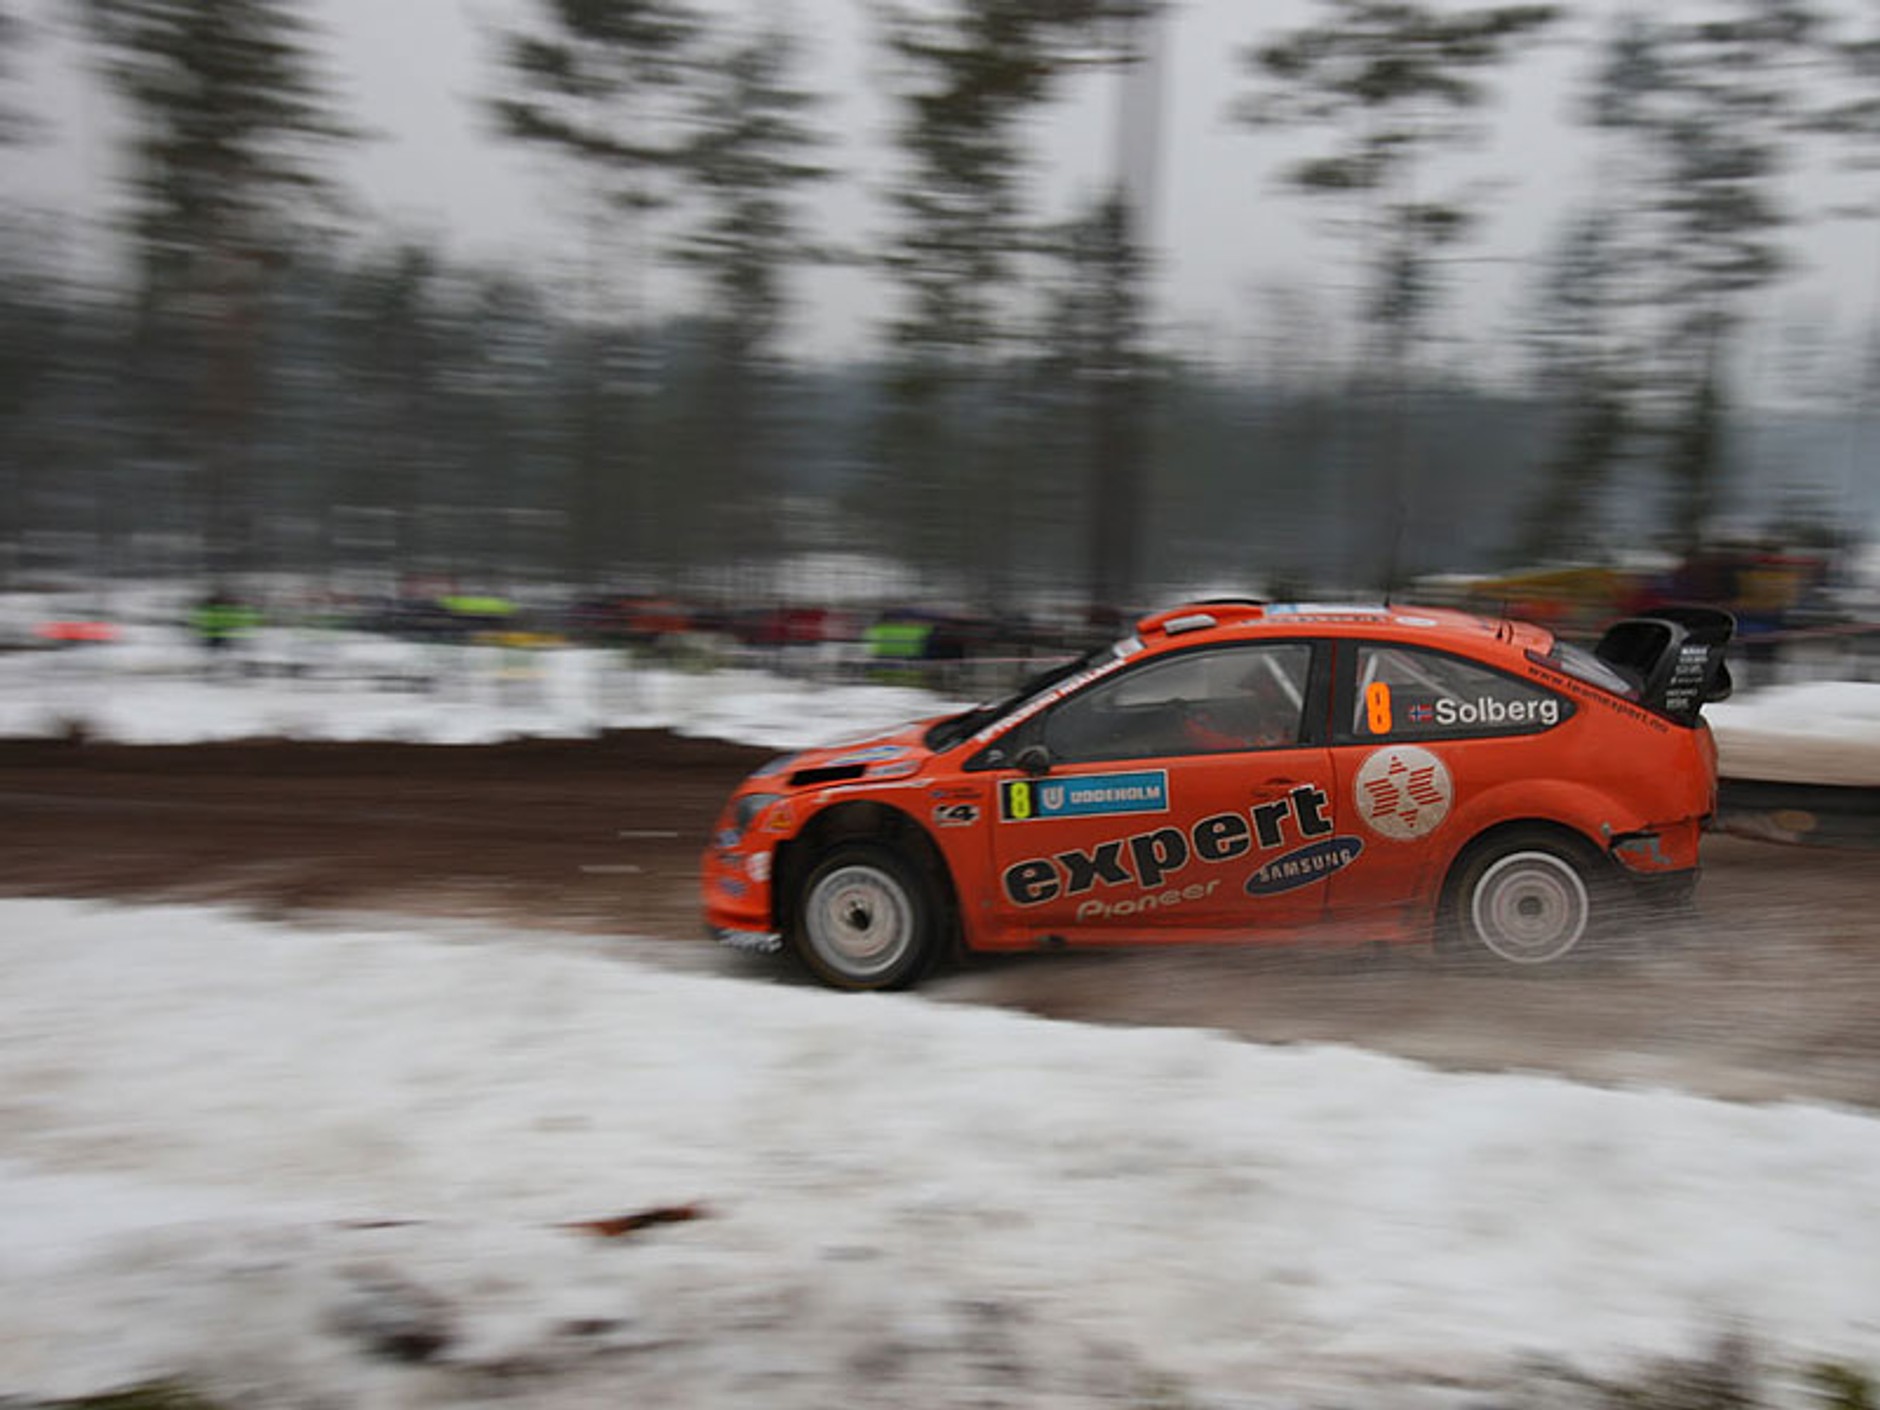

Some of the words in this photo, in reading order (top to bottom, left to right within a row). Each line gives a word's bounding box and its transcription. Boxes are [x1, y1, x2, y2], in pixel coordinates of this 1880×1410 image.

[1366, 682, 1392, 734] 8
[1435, 696, 1559, 725] Solberg
[1010, 781, 1030, 819] 8
[1003, 783, 1334, 905] expert
[1258, 848, 1352, 883] SAMSUNG
[1076, 878, 1222, 921] Pioneer
